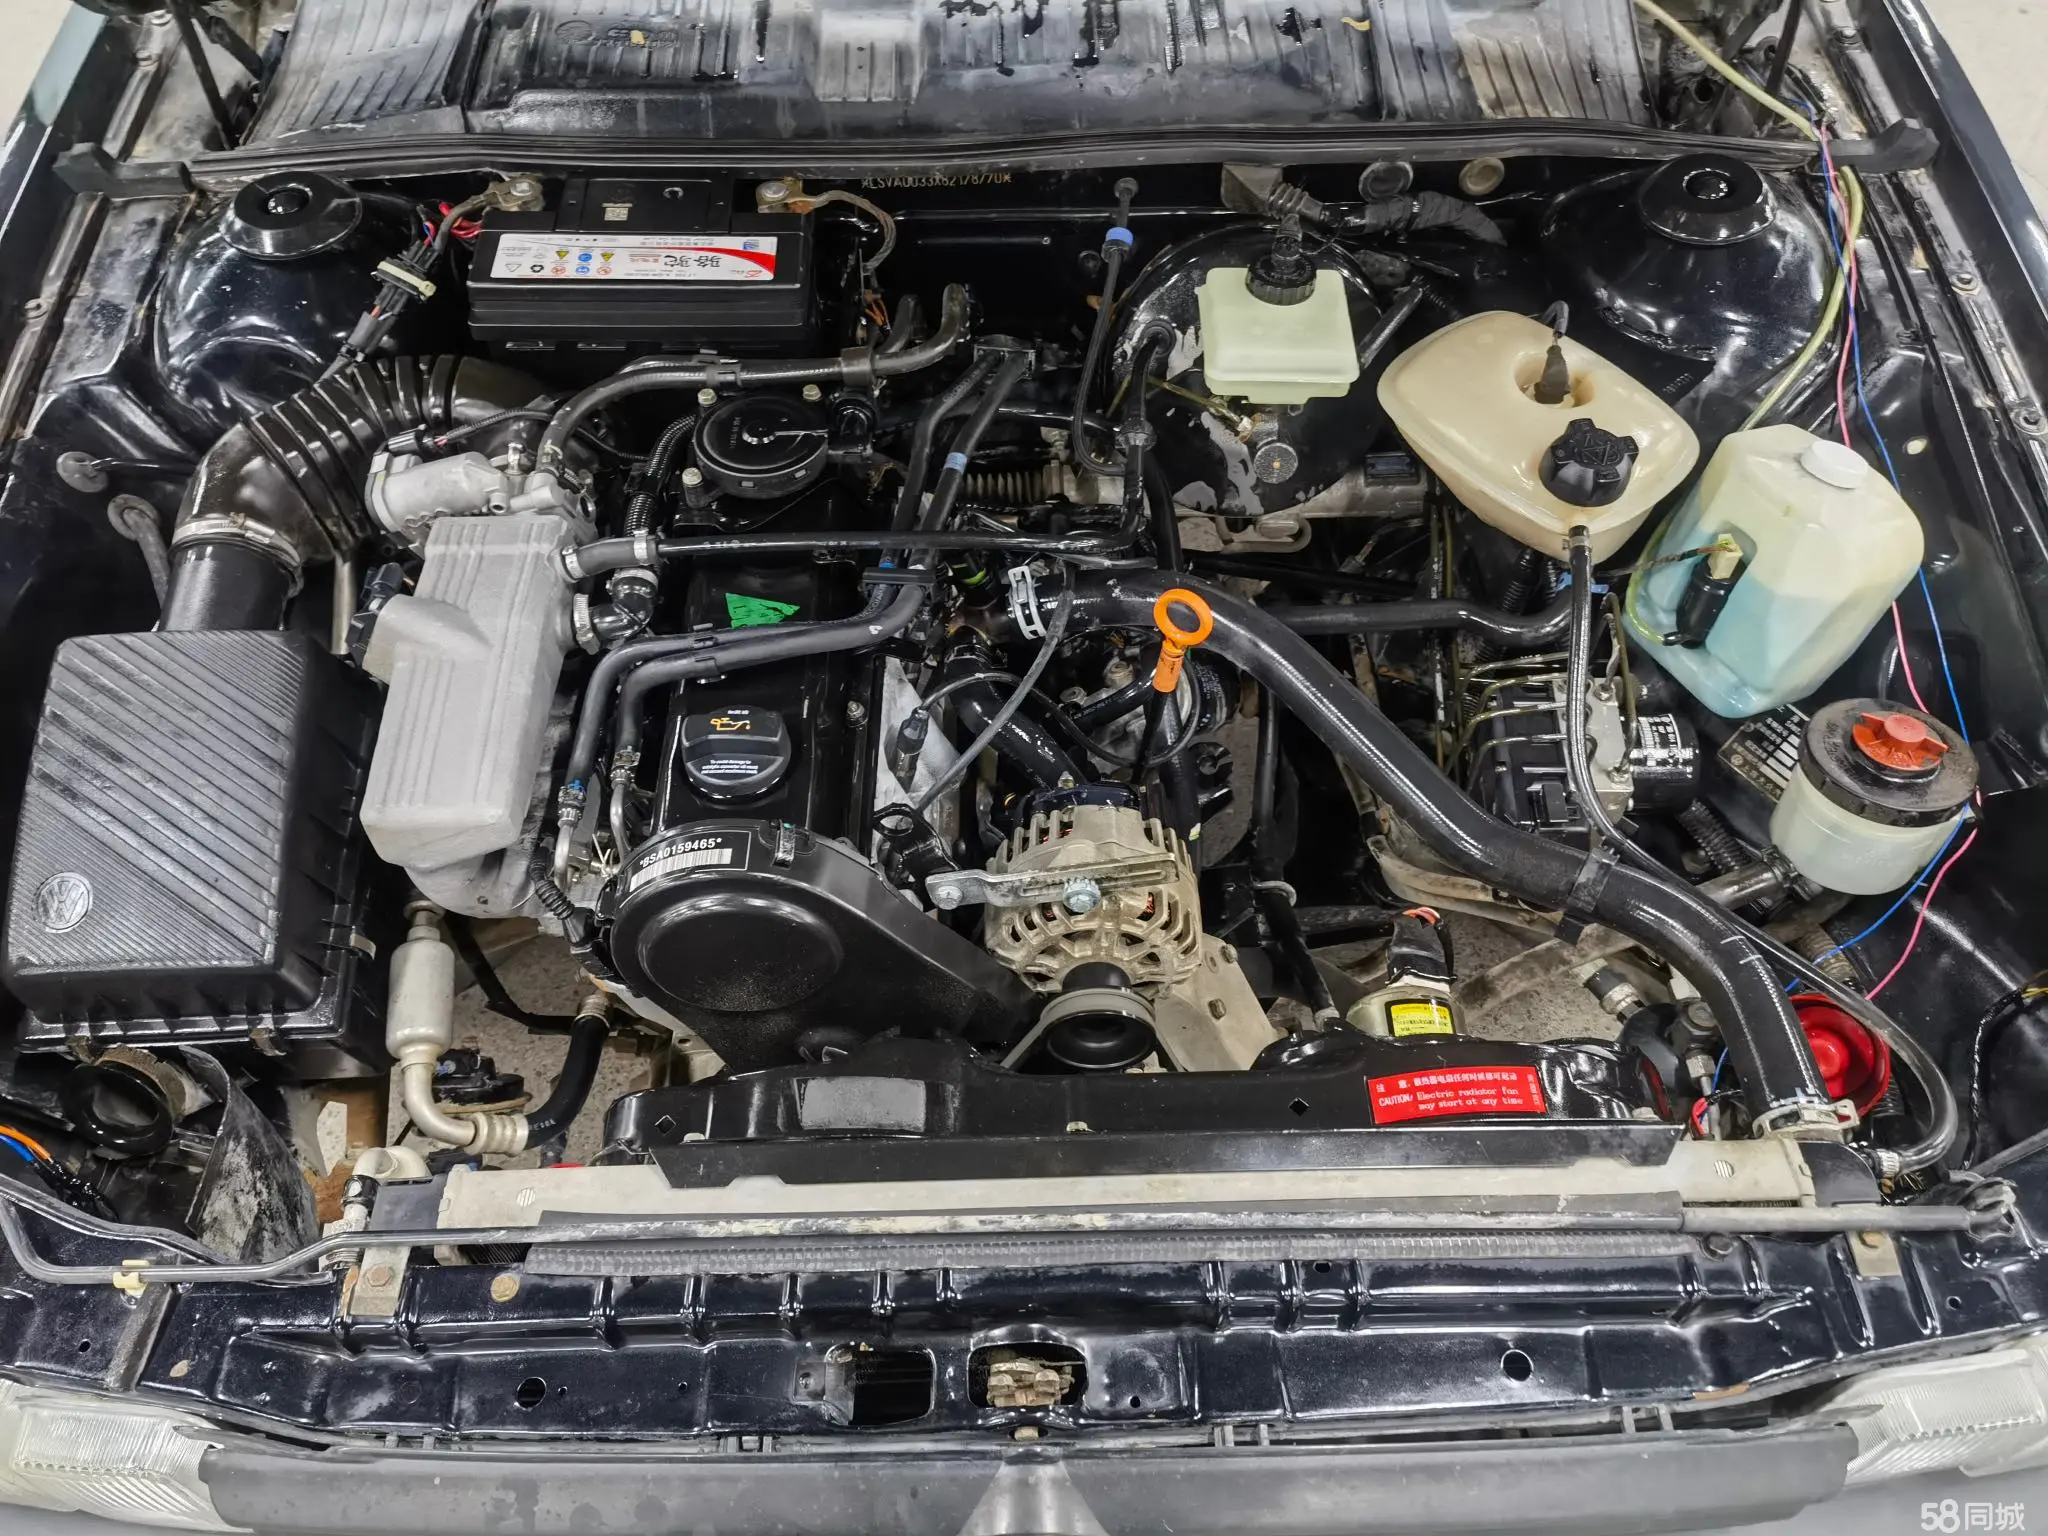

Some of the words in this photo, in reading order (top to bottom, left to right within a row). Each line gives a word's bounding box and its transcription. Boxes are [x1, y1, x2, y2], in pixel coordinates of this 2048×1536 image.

[664, 255, 722, 268] 骆驼
[1417, 1090, 1454, 1100] Electric
[1458, 1088, 1497, 1097] radiator
[1502, 1086, 1519, 1095] fan
[1418, 1102, 1435, 1110] may
[1439, 1100, 1464, 1108] start
[1481, 1098, 1497, 1106] any
[1503, 1096, 1524, 1105] time
